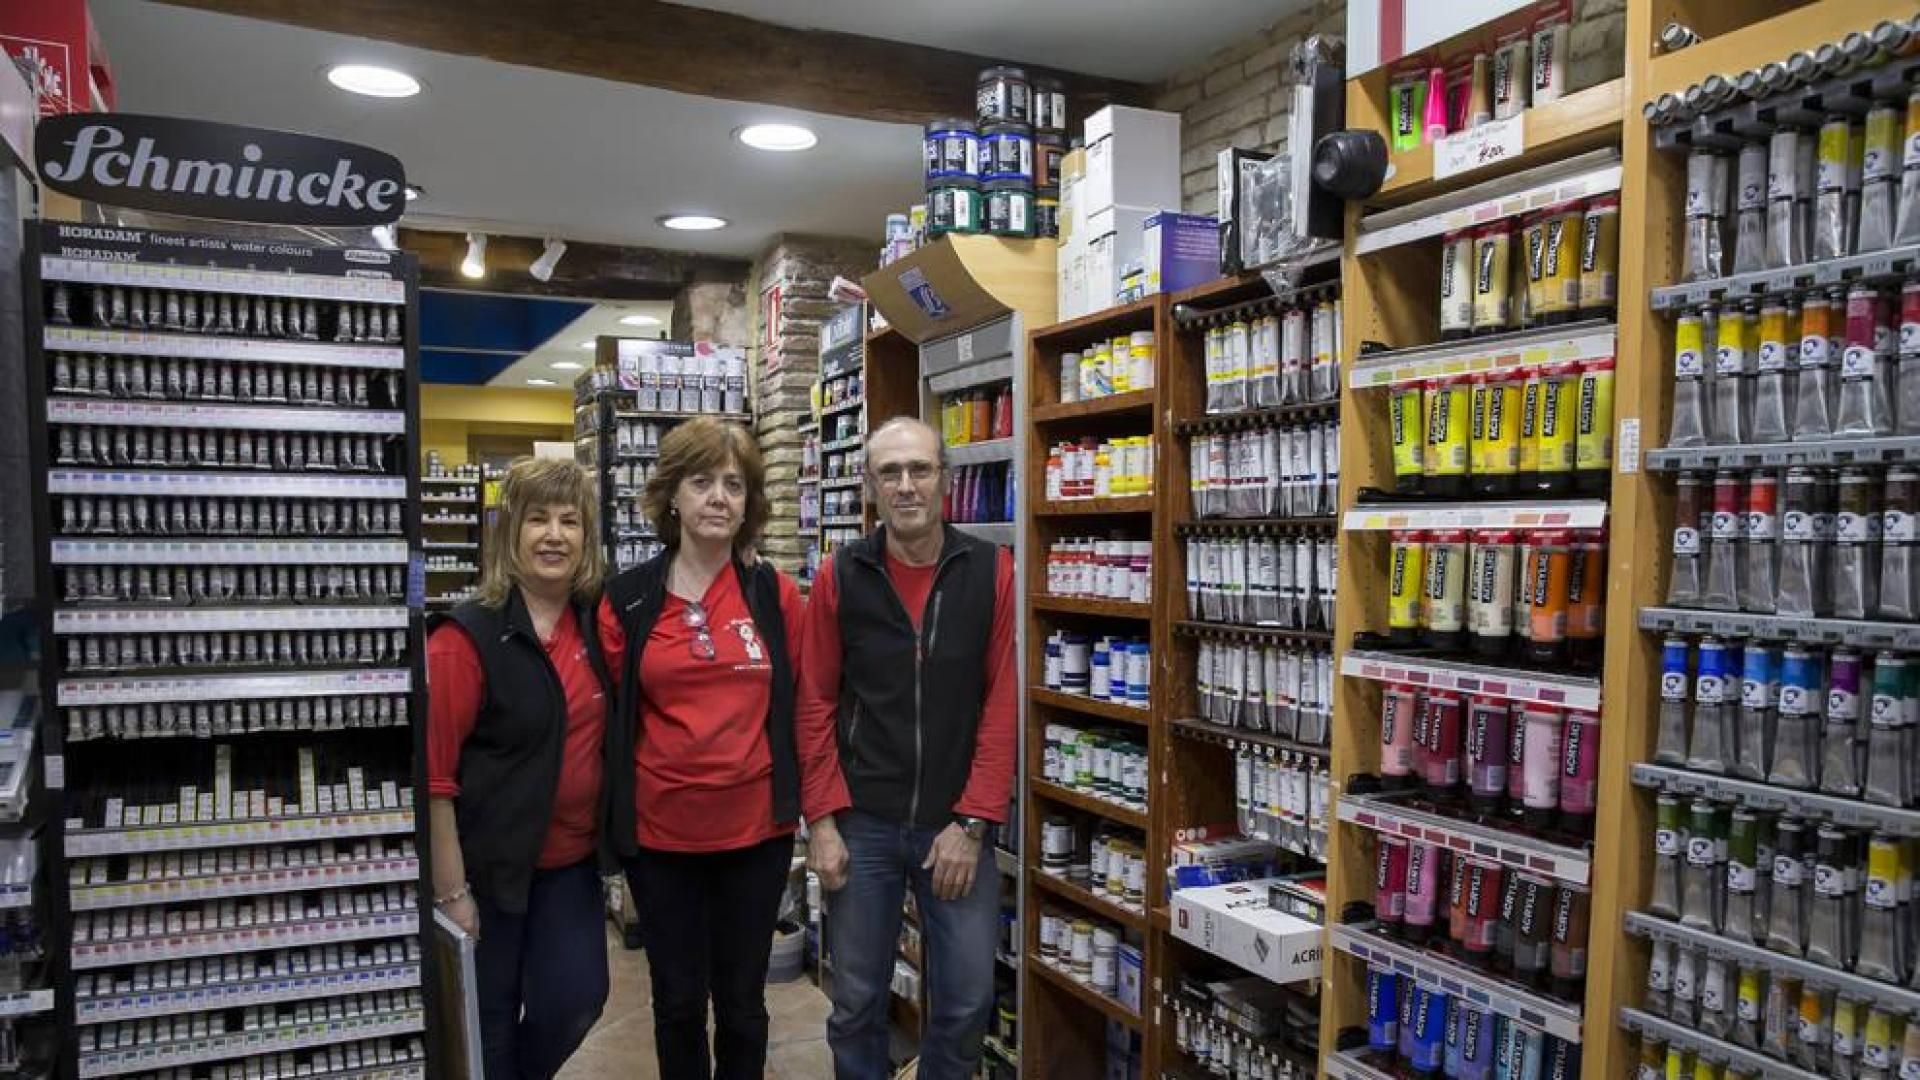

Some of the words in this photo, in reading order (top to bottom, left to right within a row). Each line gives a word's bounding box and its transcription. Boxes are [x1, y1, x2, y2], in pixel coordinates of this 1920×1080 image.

[44, 125, 399, 211] Schmincke
[59, 225, 141, 243] HORADAM
[151, 232, 185, 247] finest
[231, 241, 265, 253] water
[269, 244, 313, 257] colours
[62, 246, 137, 262] HORADAM
[1566, 724, 1580, 775] ACRYLIC
[1521, 883, 1536, 934] ACRYLIC
